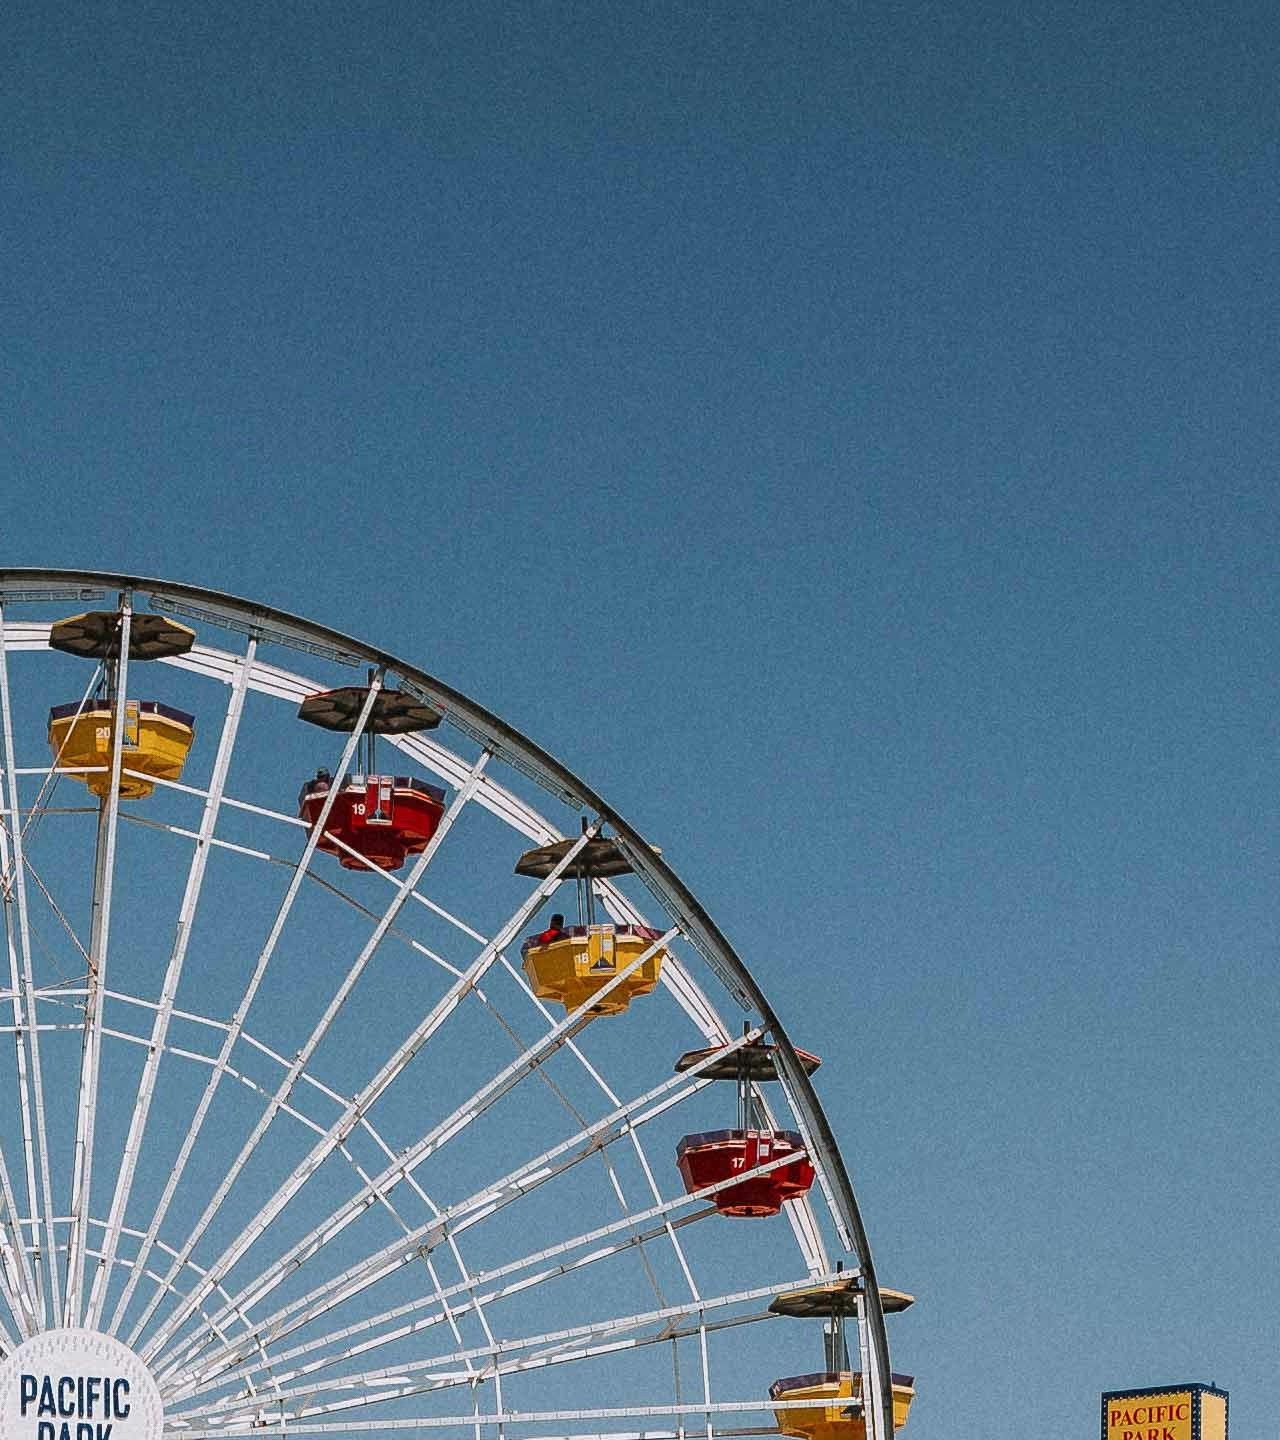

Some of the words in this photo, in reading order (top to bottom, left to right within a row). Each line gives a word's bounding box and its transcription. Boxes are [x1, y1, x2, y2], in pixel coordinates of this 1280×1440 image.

[352, 803, 366, 815] 19
[732, 1157, 746, 1169] 17
[20, 1374, 130, 1419] PACIFIC
[1110, 1403, 1189, 1428] PACIFIC
